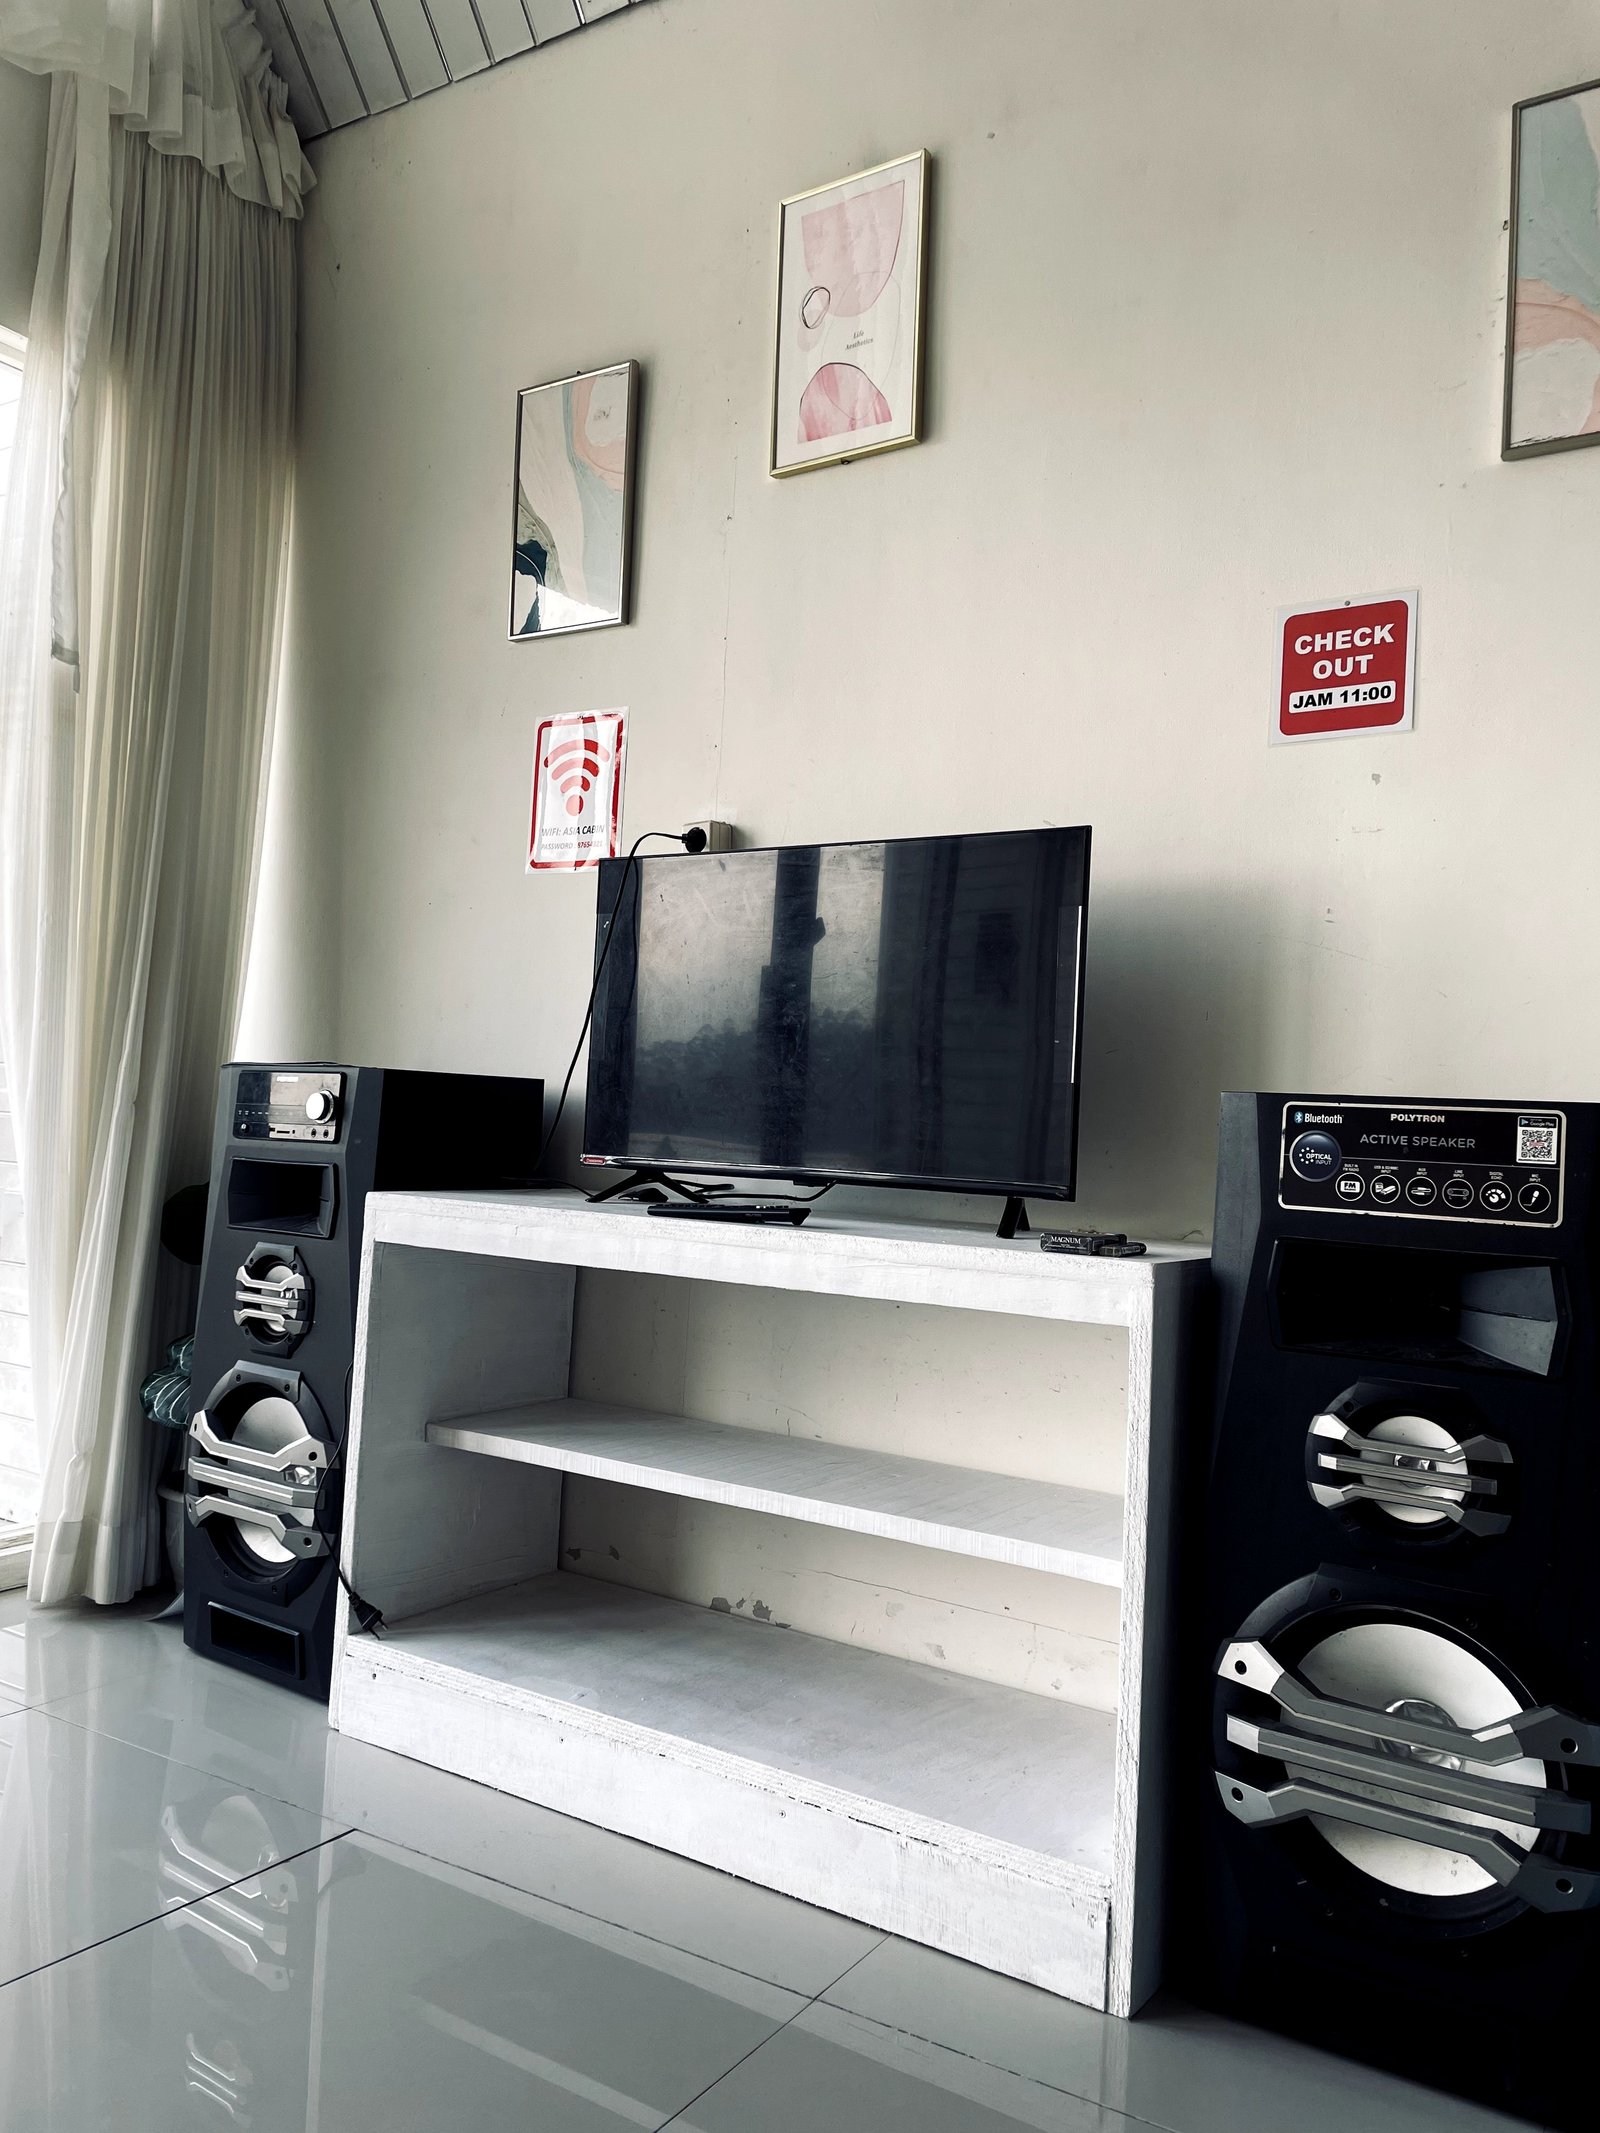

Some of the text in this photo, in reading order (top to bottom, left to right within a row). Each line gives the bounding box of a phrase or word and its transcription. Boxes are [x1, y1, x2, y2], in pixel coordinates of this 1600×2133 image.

[1294, 623, 1395, 655] CHECK
[1312, 654, 1374, 680] OUT
[1293, 685, 1392, 709] JAM 11:00
[582, 825, 605, 835] CABIN
[1304, 1113, 1343, 1124] Bluetooth
[1390, 1113, 1445, 1123] POLYTRON
[1360, 1134, 1476, 1149] ACTIVE SPEAKER
[1305, 1152, 1332, 1160] OPTICAL
[1050, 1235, 1081, 1244] MAGNUM
